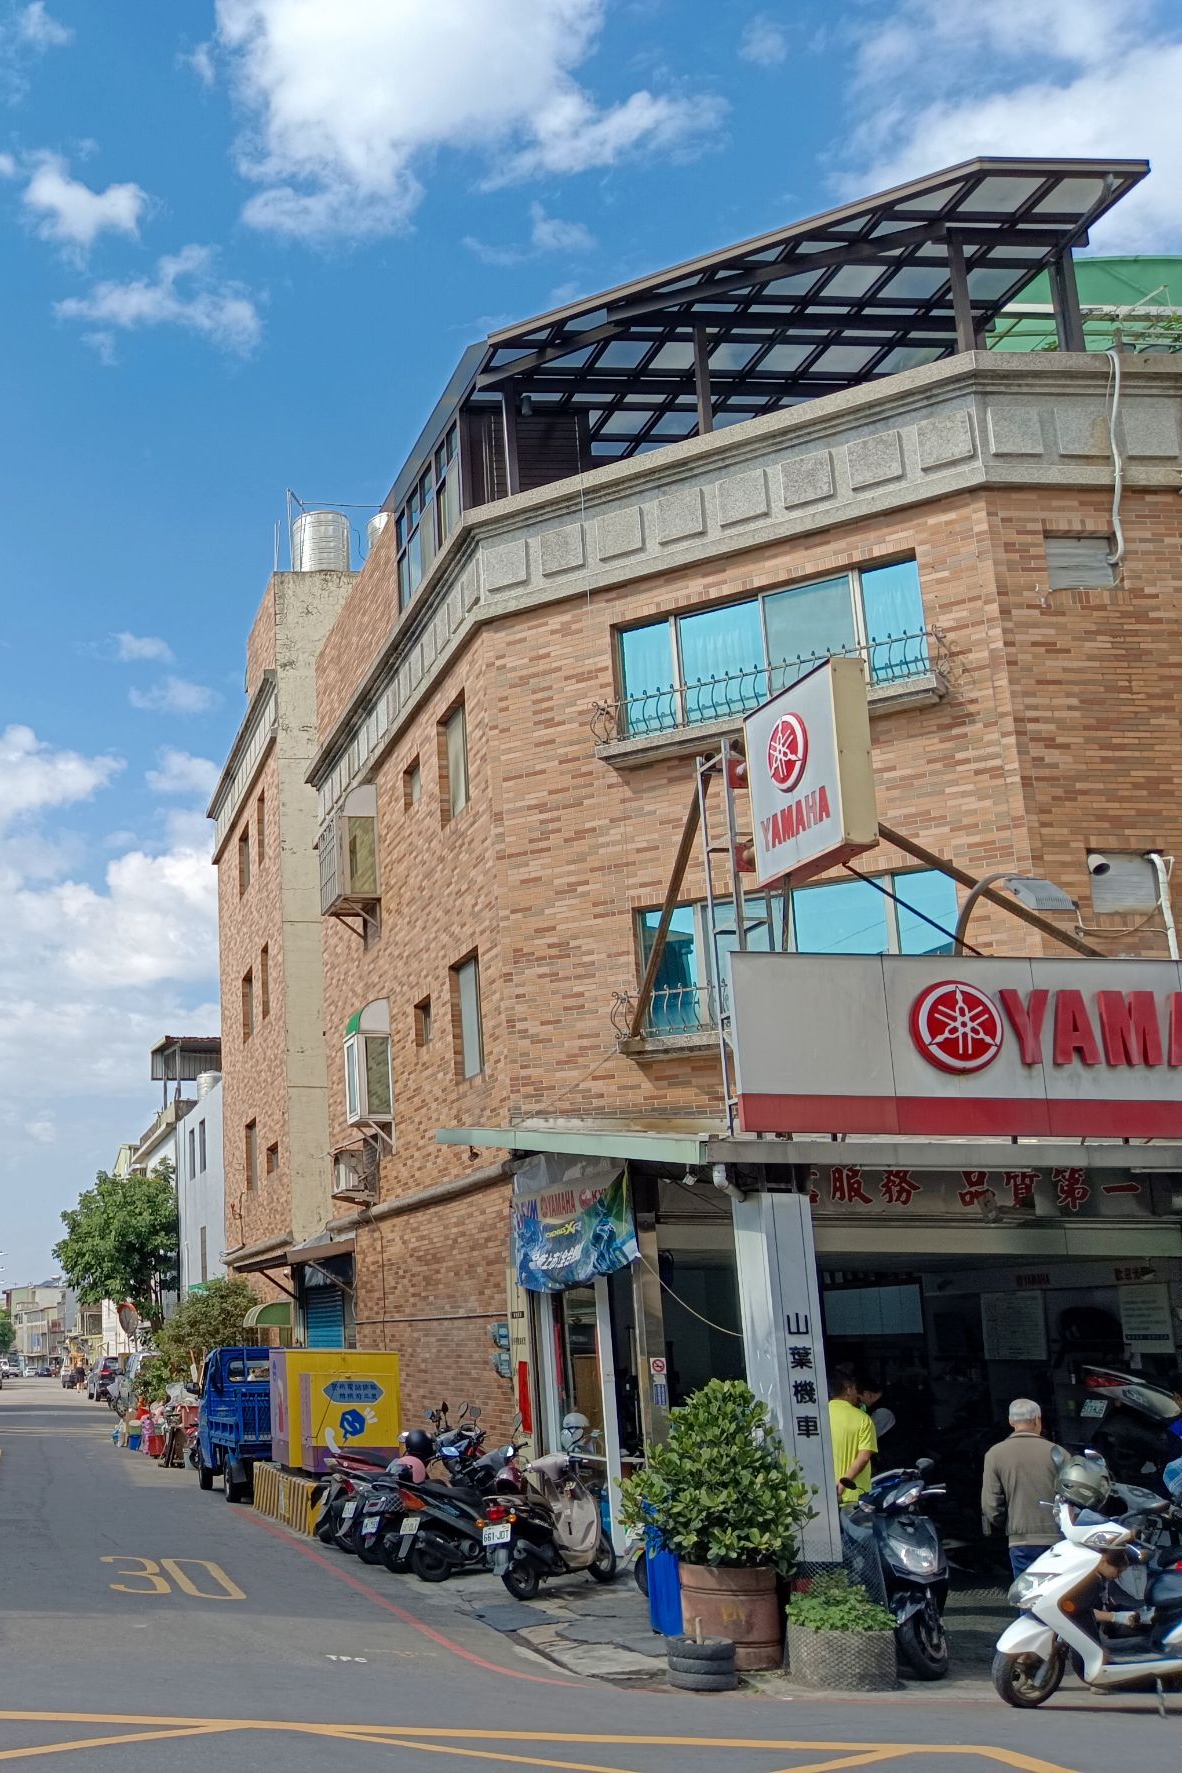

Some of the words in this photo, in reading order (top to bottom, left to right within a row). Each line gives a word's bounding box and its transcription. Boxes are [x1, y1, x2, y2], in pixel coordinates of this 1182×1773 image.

[760, 785, 831, 852] YAMAHA
[548, 1189, 577, 1217] YAMAHA
[956, 1166, 1141, 1212] 品質第一
[786, 1312, 819, 1438] 山葉機車
[100, 1556, 247, 1599] 30
